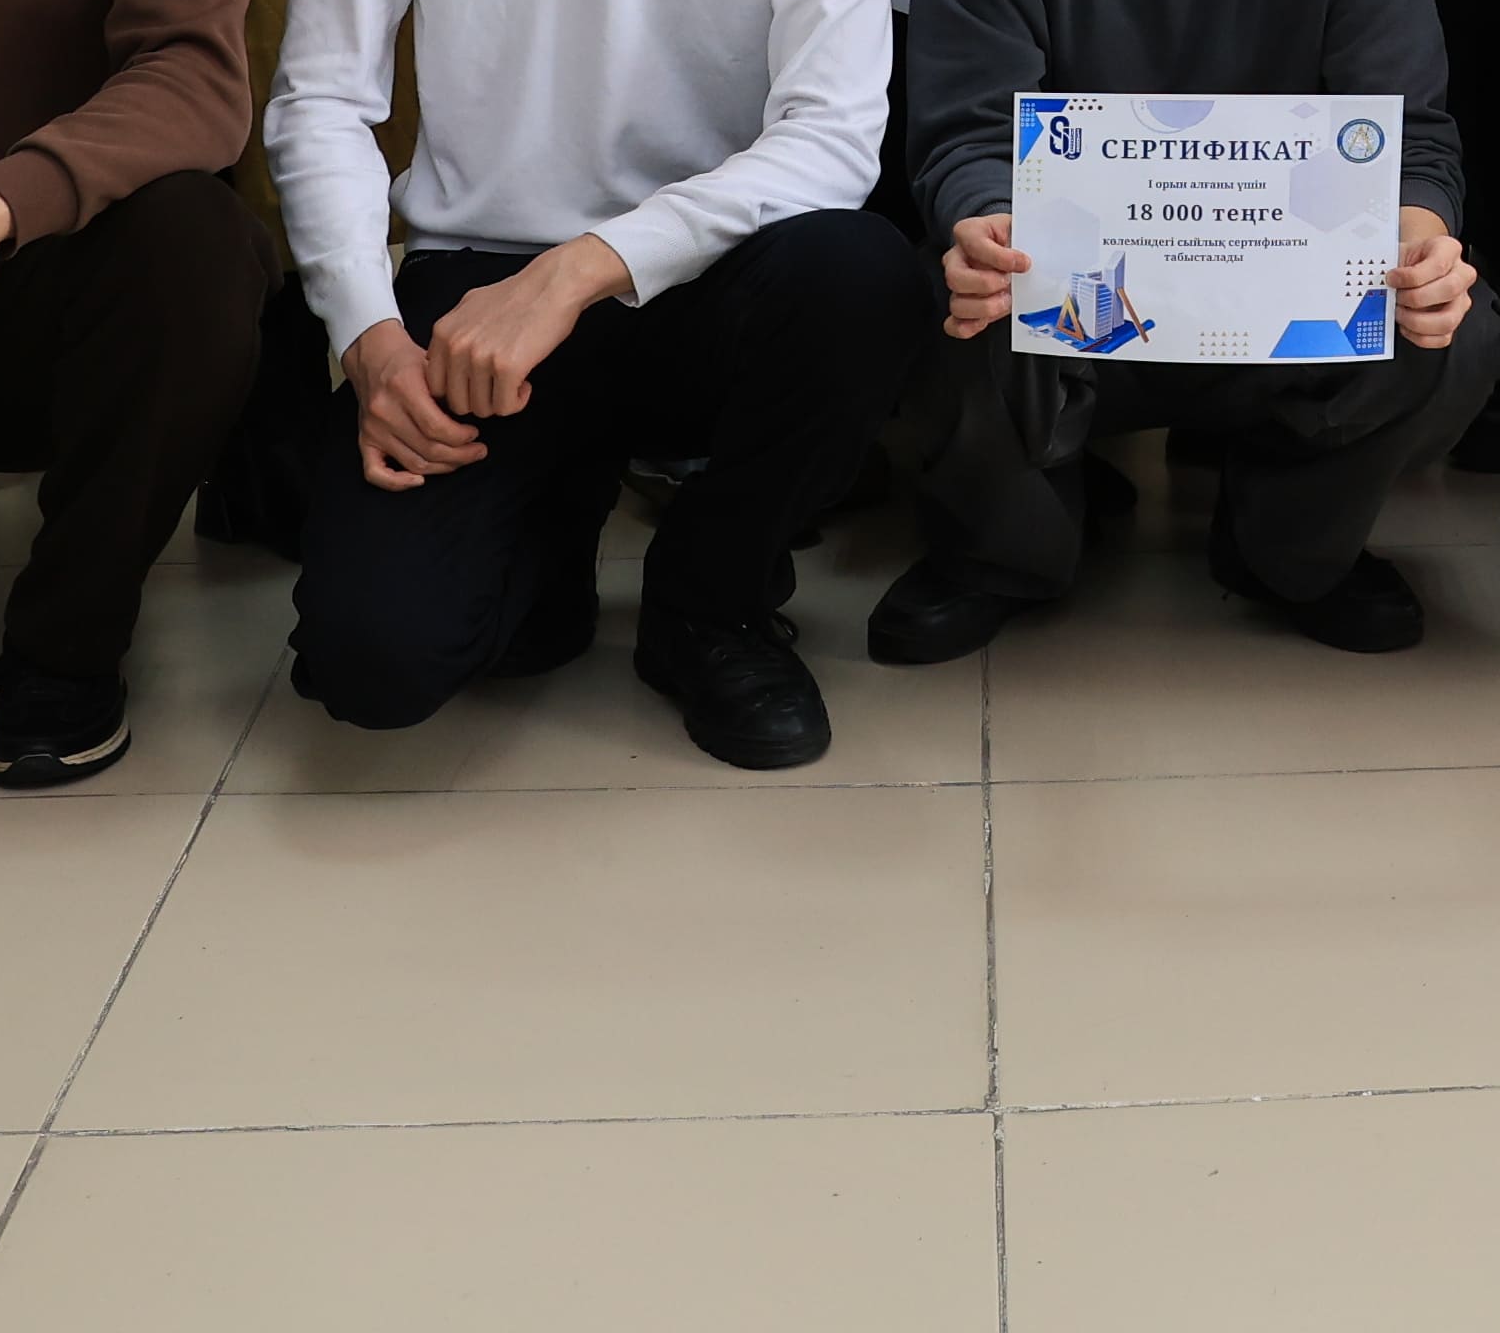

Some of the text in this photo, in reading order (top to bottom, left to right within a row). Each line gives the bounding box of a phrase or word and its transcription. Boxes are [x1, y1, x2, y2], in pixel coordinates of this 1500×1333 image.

[1101, 138, 1314, 161] СЕРТИФИКАТ
[1155, 181, 1188, 191] орын
[1236, 179, 1267, 192] үшін
[1127, 203, 1284, 225] 18 000 теңге
[1177, 236, 1226, 249] сыйлық
[1228, 236, 1308, 249] сертификаты
[1164, 252, 1244, 263] табысталады
